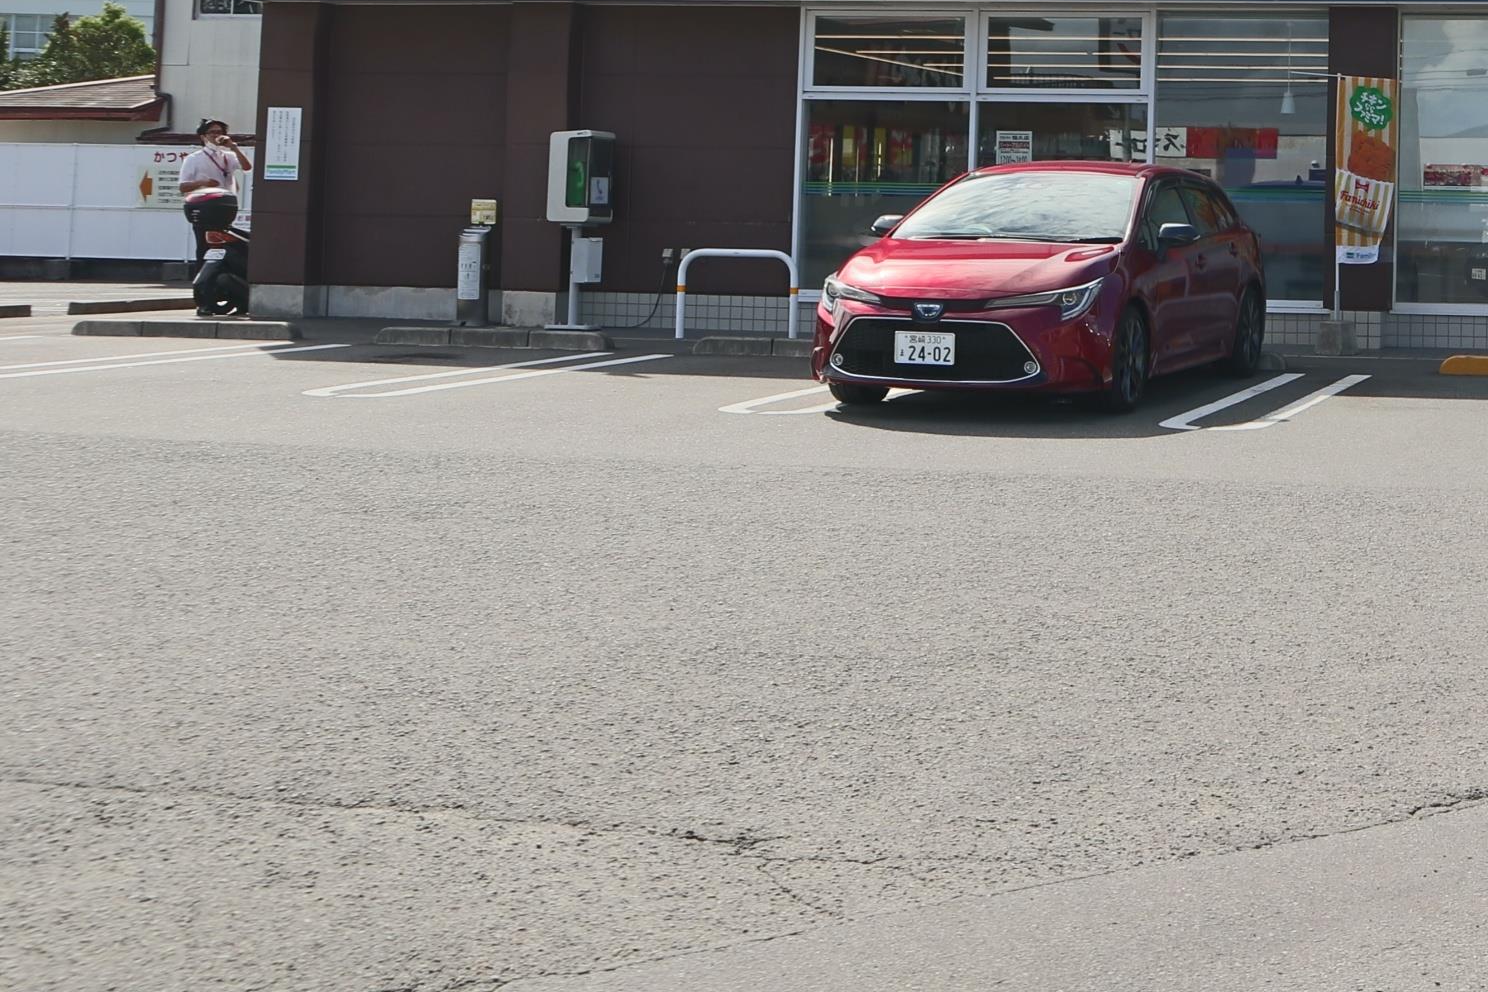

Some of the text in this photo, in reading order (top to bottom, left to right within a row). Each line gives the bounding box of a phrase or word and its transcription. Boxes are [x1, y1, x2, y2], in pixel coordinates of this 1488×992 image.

[1340, 190, 1380, 210] Famichiki
[927, 335, 942, 344] 330
[908, 345, 951, 363] 24-02
